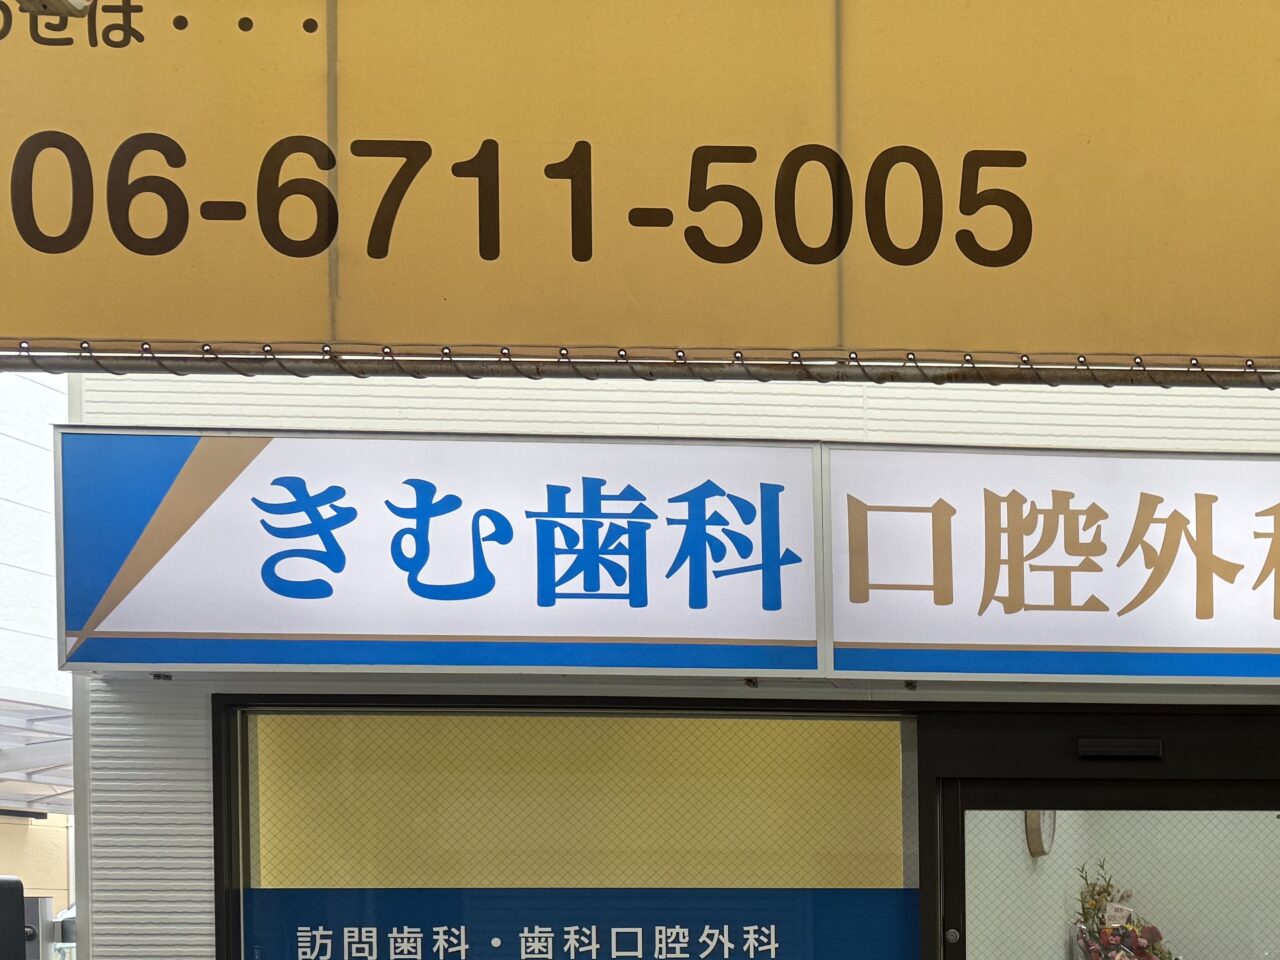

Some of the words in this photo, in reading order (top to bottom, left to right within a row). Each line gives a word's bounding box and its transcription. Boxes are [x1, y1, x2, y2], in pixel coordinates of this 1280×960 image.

[11, 130, 1032, 267] 06-6711-5005
[296, 924, 779, 960] 訪問歯科・歯科口腔外科
